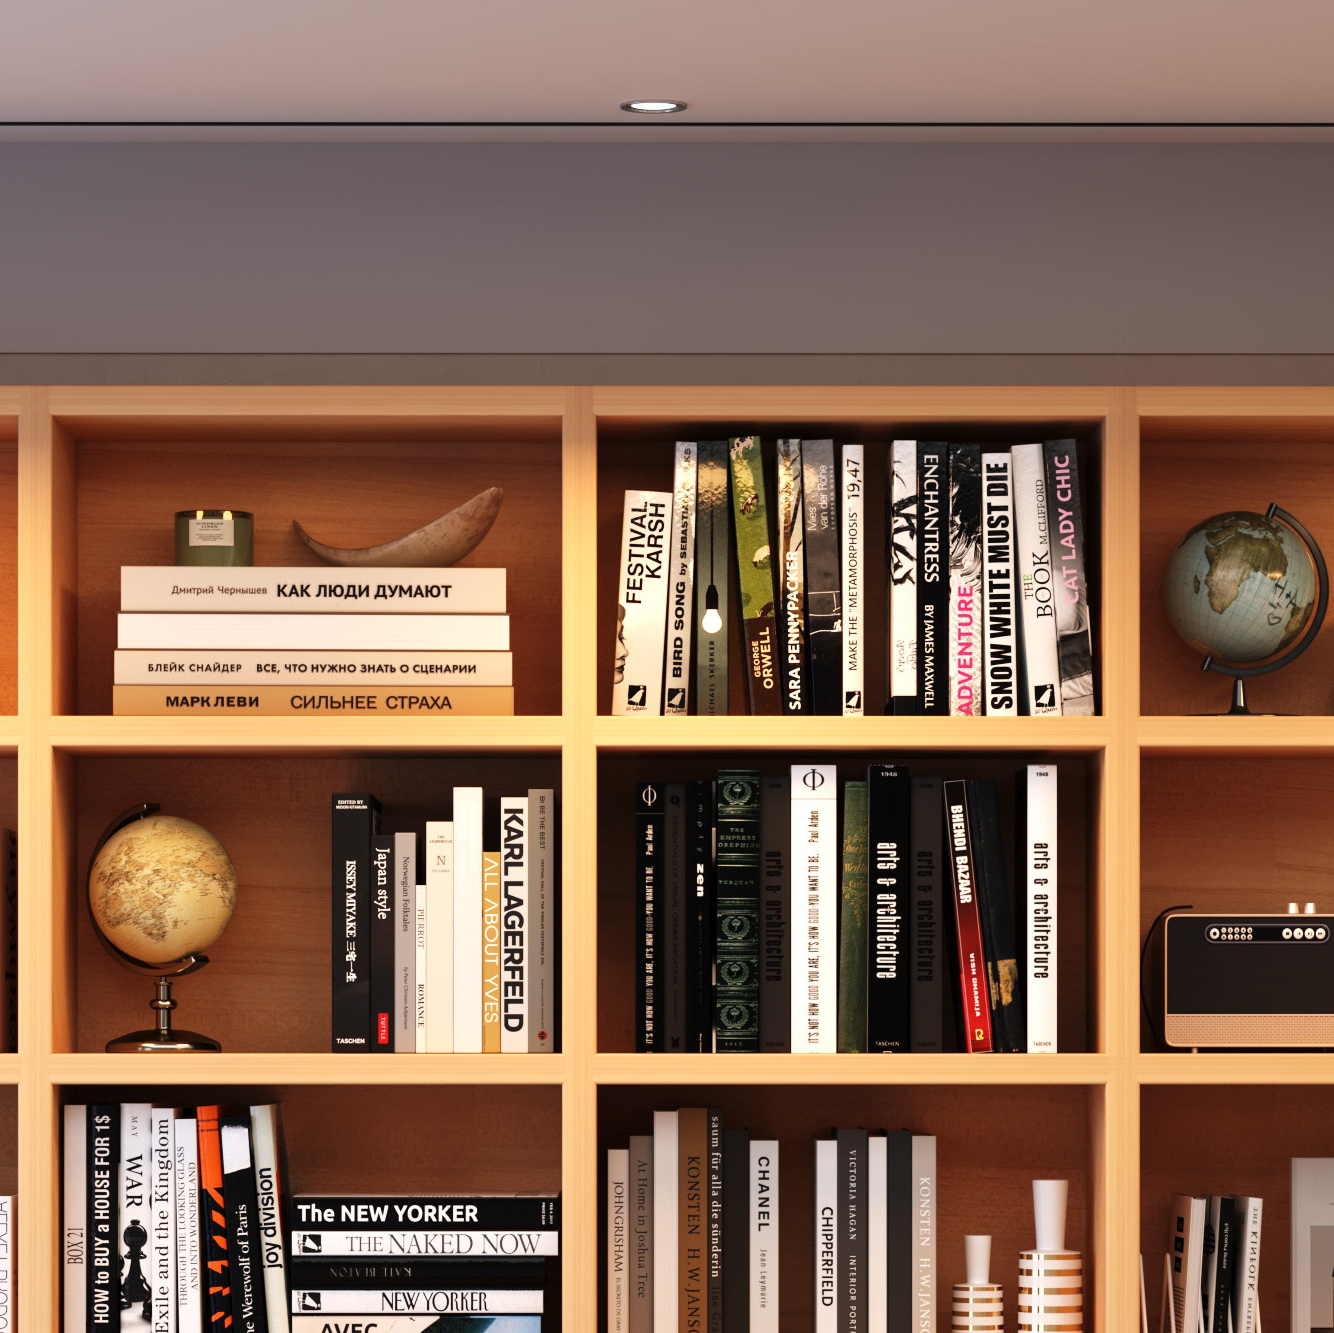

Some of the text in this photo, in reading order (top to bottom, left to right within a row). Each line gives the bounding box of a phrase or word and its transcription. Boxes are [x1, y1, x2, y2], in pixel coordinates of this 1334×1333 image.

[626, 502, 647, 604] FESTIVAL
[646, 503, 665, 579] KARSH
[171, 585, 452, 600] Дмитрий Чернышев КАК ЛЮДИ ДУМАЮТ
[672, 582, 686, 678] BIRD SONG
[752, 640, 761, 678] GEORGE
[759, 627, 774, 689] ORWELL
[786, 551, 802, 710] SARA PENNYPACKER
[165, 696, 452, 710] МАРК ЛЕВИ СИЛЬНЕЕ СТРАХА
[345, 860, 357, 892] ISSEY
[374, 848, 390, 920] Japan style
[876, 842, 900, 869] arts
[950, 805, 972, 904] BHENDI BAZAAR
[345, 892, 357, 938] MIYAKE
[503, 808, 524, 1032] KARL LAGERFELD
[876, 893, 901, 979] architecture
[484, 974, 499, 1023] YVES
[126, 1154, 143, 1209] WAR
[257, 1168, 282, 1268] joy division
[297, 1203, 478, 1223] The NEW YORKER
[687, 1155, 700, 1235] KONSTEN
[758, 1156, 770, 1232] CHANEL
[94, 1115, 111, 1324] HOW to BUY a HOUSE FOR 1$
[346, 1233, 542, 1254] THE NAKED NOW
[821, 1206, 833, 1307] CHIPPERFIELD
